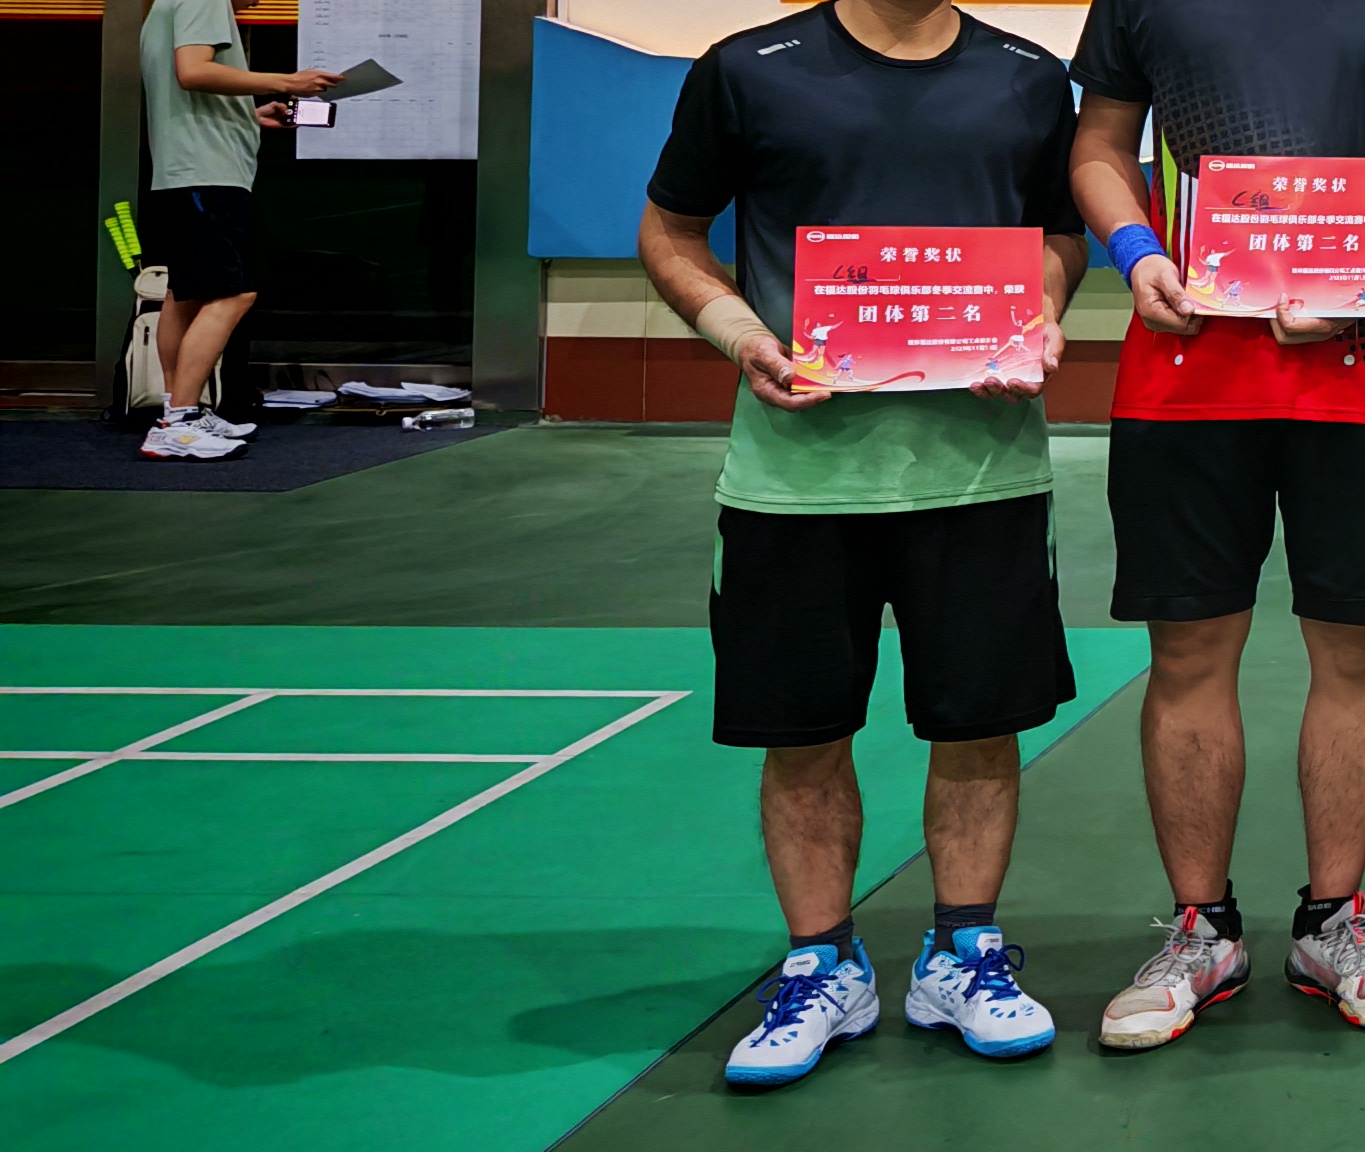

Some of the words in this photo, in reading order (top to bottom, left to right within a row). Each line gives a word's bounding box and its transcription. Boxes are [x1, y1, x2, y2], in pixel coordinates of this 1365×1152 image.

[1272, 177, 1347, 194] 荣誉奖状
[1248, 233, 1360, 252] 团体第二名
[880, 247, 962, 263] 荣誉奖状
[858, 304, 982, 323] 团体第二名
